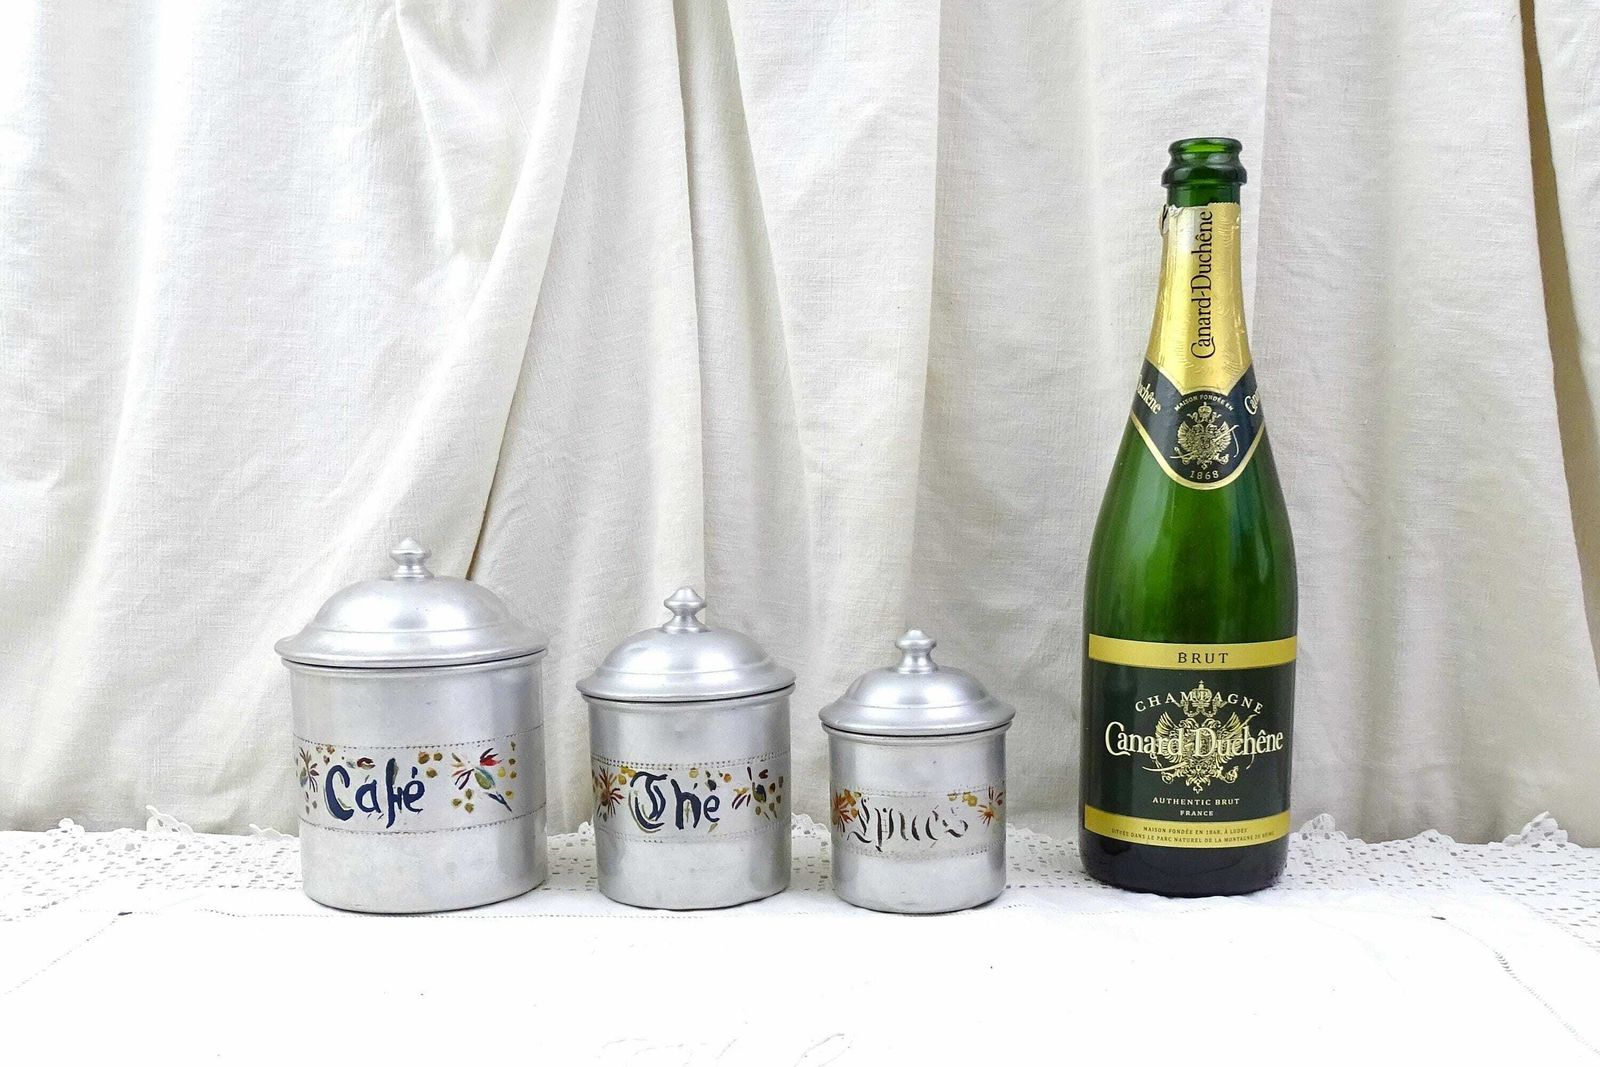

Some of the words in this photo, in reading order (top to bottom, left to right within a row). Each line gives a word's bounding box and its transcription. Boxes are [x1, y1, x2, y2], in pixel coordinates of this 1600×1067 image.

[1190, 211, 1216, 359] Canard-Duchêne
[1174, 395, 1198, 412] MAISON
[1189, 470, 1220, 480] 1868
[1177, 652, 1229, 664] BRUT
[1135, 691, 1264, 715] CHAMPAGNE
[1105, 721, 1284, 757] Canard-Duchêne
[323, 757, 426, 829] Café
[1152, 796, 1211, 806] AUTHENTIC
[1214, 798, 1240, 806] BRUT
